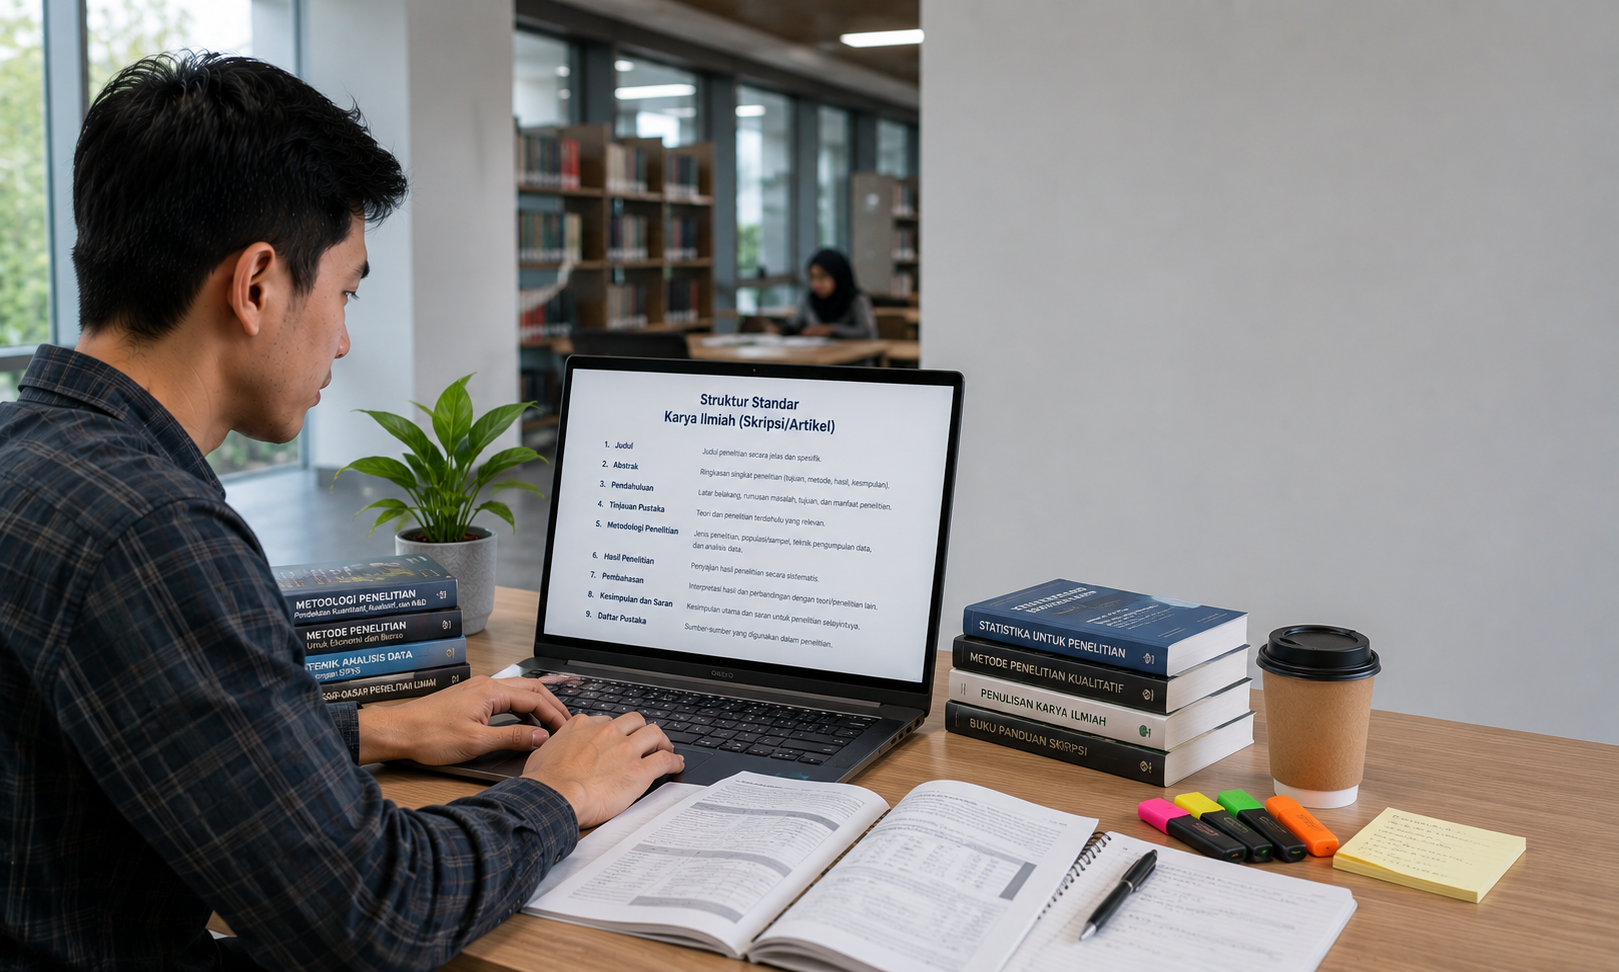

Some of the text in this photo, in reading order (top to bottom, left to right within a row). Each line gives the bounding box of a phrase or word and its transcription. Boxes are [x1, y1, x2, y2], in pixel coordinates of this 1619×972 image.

[700, 393, 799, 410] Struktur Standar
[664, 410, 836, 435] Karya Ilmiah (Skripsi/Artikel)
[769, 452, 783, 460] jelas
[613, 461, 639, 470] Abstrak
[700, 469, 730, 477] Ringkasan
[731, 471, 752, 479] singkat
[807, 477, 833, 485] metode,
[834, 478, 850, 486] hasil,
[611, 481, 654, 491] Pendahuluan
[610, 501, 637, 511] Tinjauan
[639, 504, 665, 513] Pustaka
[714, 490, 742, 500] belakang,
[833, 500, 858, 508] manfaat
[697, 509, 711, 517] Teori
[785, 517, 800, 526] yang
[607, 521, 644, 533] Metodologi
[645, 525, 678, 535] Penelitian
[728, 545, 743, 553] data.
[813, 541, 855, 550] pengumpulan
[856, 544, 872, 553] data,
[604, 553, 620, 561] Hasil
[622, 555, 654, 564] Penelitian
[602, 573, 644, 584] Pembahasan
[691, 562, 719, 572] Penyajian
[720, 565, 733, 573] hasil
[765, 571, 785, 579] secara
[787, 573, 819, 582] sistematis.
[359, 589, 416, 603] PENELITIAN
[600, 592, 638, 602] Kesimpulan
[654, 599, 673, 607] Saran
[689, 582, 722, 591] Interpretasi
[722, 586, 736, 594] hasil
[749, 590, 791, 601] perbandingan
[792, 595, 815, 604] dengan
[586, 610, 647, 624] 9. Daftar Pustaka
[687, 603, 720, 613] Kesimpulan
[754, 611, 771, 619] saran
[307, 621, 407, 640] METODE PENELITIAN
[684, 623, 731, 635] Sumber-sumber
[732, 629, 747, 638] yang
[748, 632, 779, 641] digunakan
[780, 636, 799, 644] dalam
[979, 620, 1126, 658] STATISTIKA UNTUK PENELITIAN
[387, 650, 413, 661] DATA
[970, 652, 1124, 694] METODE PENELITIAN KUALITATIF
[980, 688, 1106, 727] PENULISAN KARYA ILMIAH
[970, 718, 996, 734] BUKU
[999, 725, 1047, 746] PANDUAN
